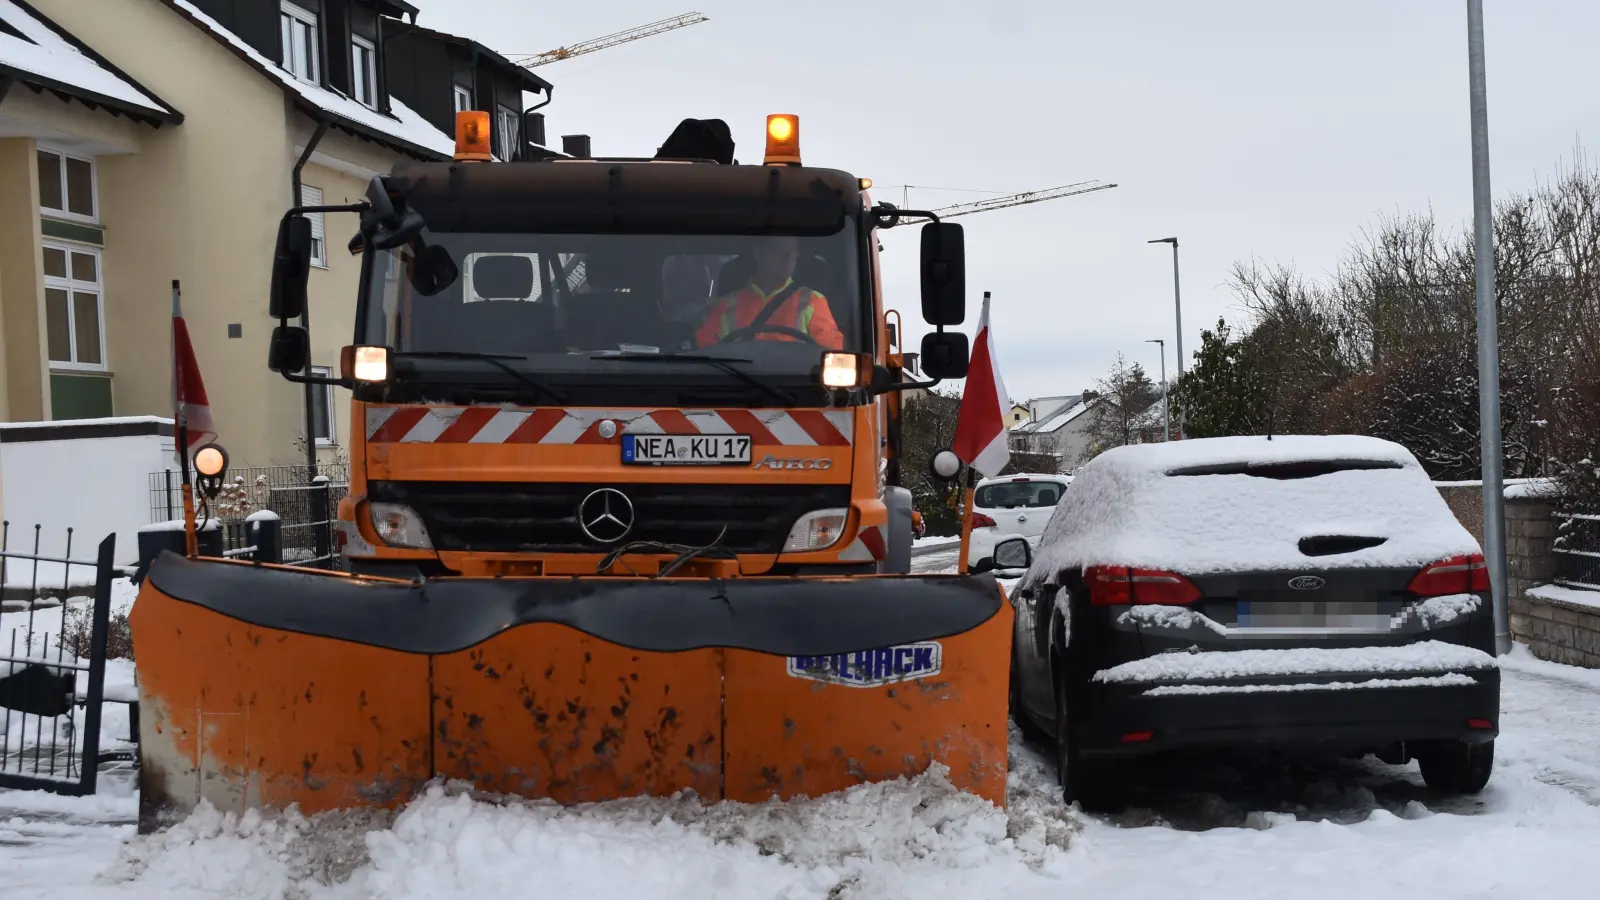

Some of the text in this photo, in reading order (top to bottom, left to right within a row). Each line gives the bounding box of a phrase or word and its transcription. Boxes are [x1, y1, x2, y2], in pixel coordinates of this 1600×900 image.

[635, 438, 749, 458] NEA KU 17
